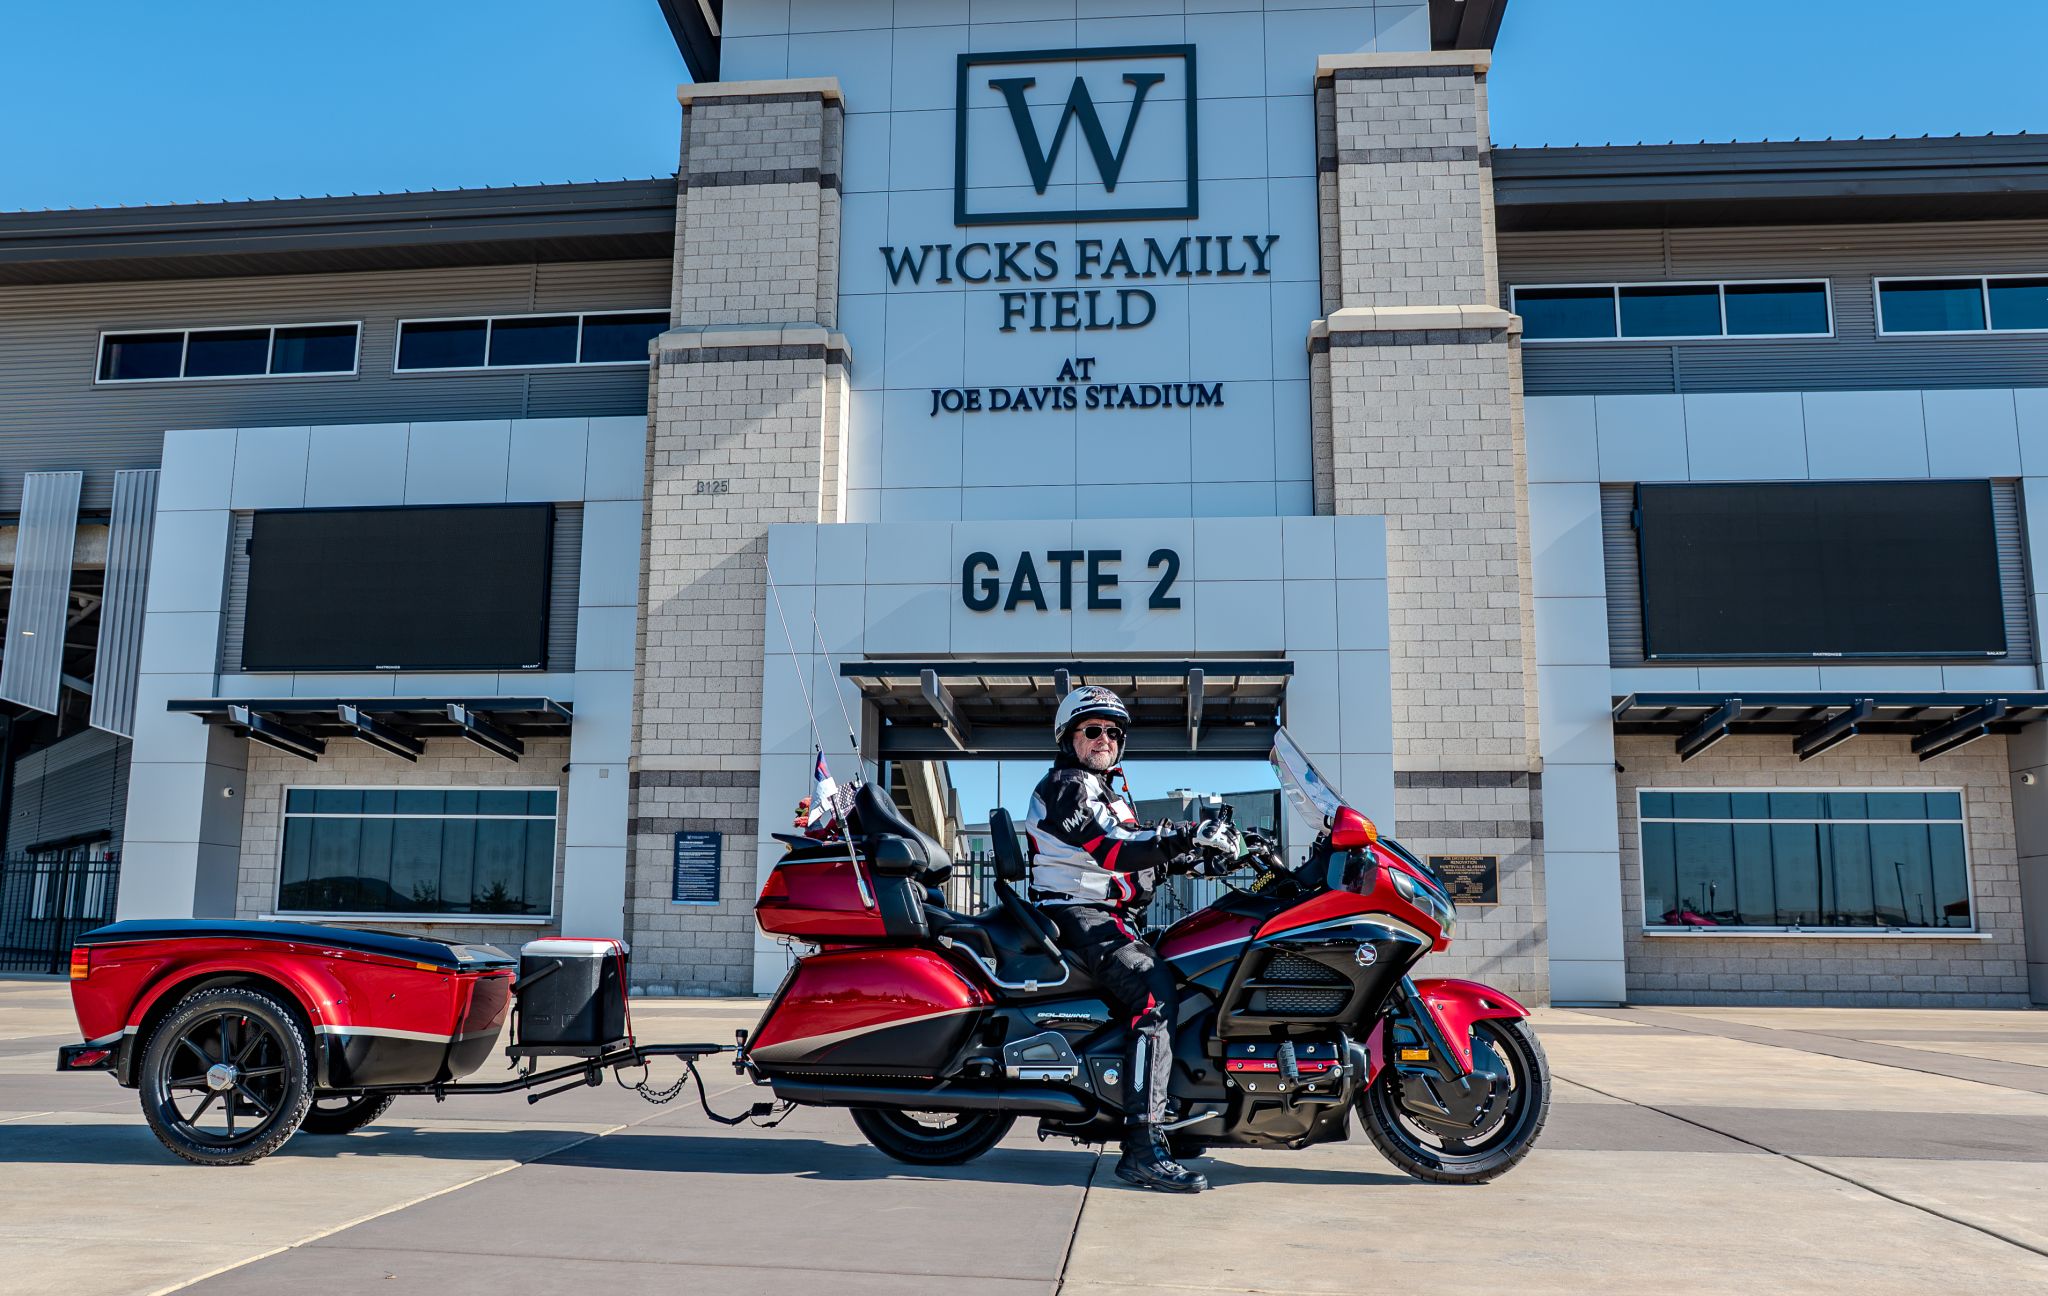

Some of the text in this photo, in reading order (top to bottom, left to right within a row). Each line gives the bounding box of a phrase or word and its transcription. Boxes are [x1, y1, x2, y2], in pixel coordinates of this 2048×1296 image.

[987, 72, 1166, 196] W
[879, 234, 1281, 286] WICKS FAMILY
[998, 288, 1157, 333] FIELD
[1056, 357, 1096, 383] AT
[930, 382, 1225, 417] JOE DAVIS STADIUM
[697, 480, 728, 493] 3125
[961, 548, 1181, 613] GATE 2
